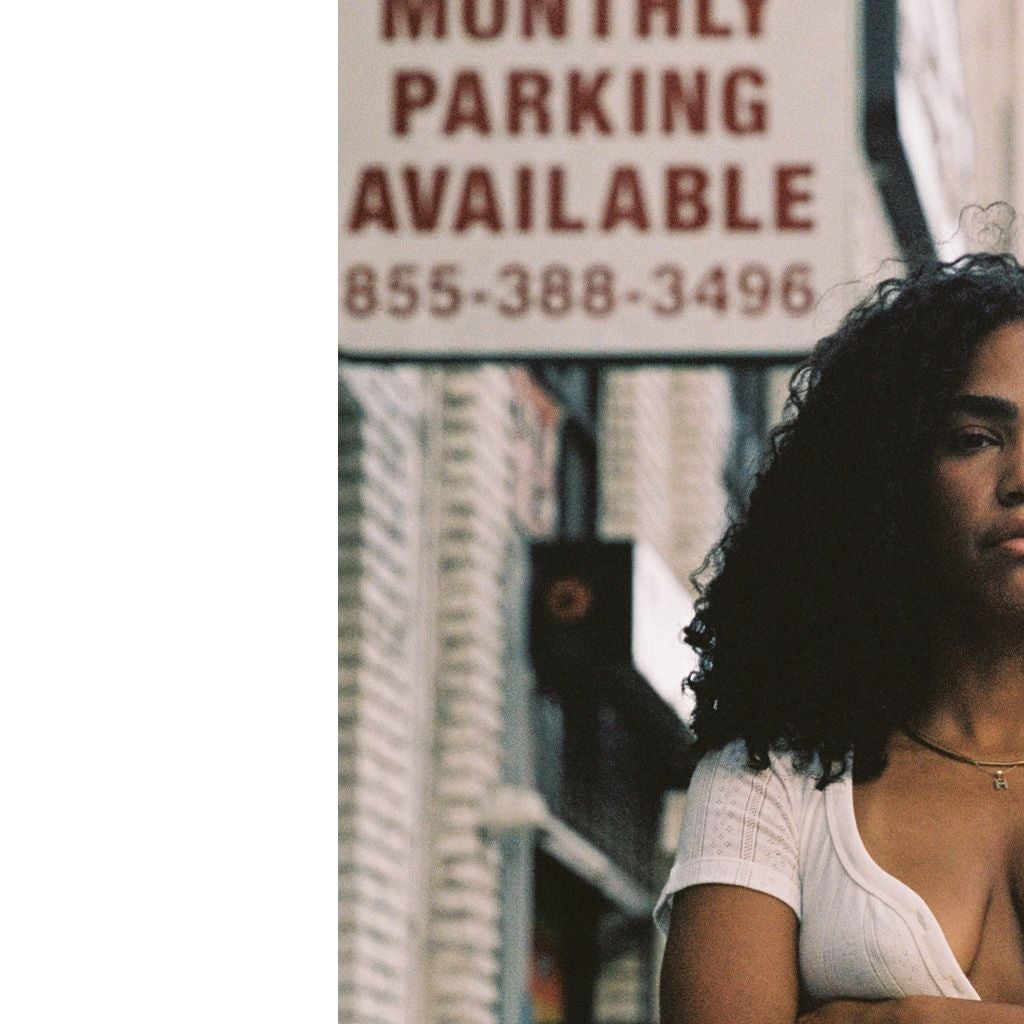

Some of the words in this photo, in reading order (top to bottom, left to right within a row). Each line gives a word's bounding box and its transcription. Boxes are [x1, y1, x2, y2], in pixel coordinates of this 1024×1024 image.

[380, 0, 768, 41] MONTHLY
[391, 67, 768, 137] PARKING
[347, 165, 815, 234] AVAILABLE
[344, 262, 815, 320] 855-388-3496
